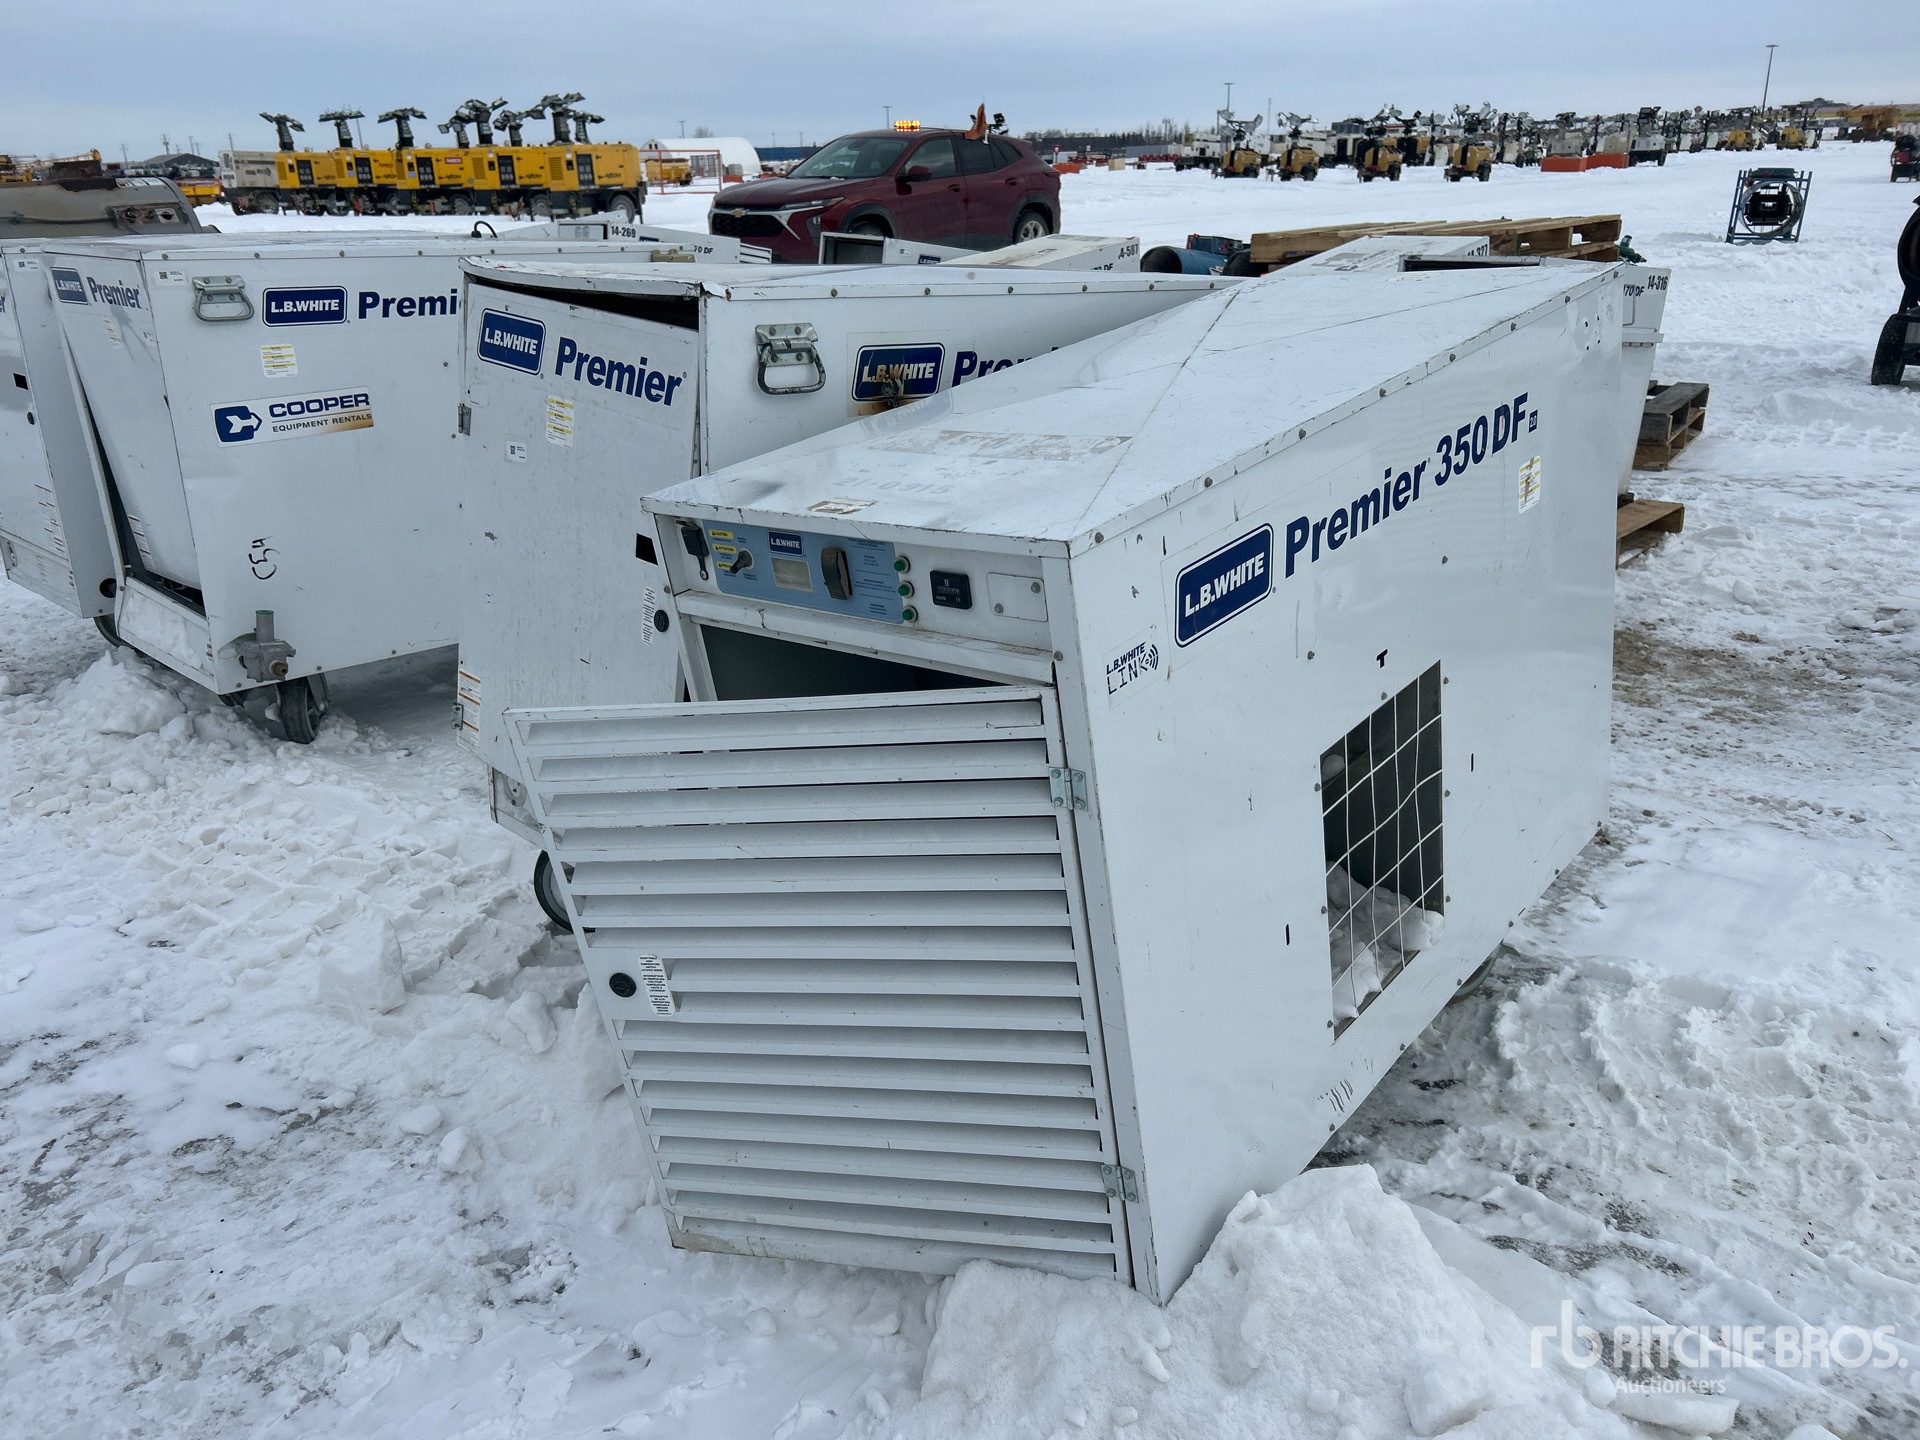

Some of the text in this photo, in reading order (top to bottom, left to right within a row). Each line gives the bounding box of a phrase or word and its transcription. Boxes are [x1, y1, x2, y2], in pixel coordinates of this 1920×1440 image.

[610, 225, 637, 239] 14-269
[86, 276, 141, 309] Premier
[1647, 274, 1669, 291] 14-316
[271, 299, 340, 314] L.B.WHITE
[358, 288, 461, 320] Premi
[484, 327, 539, 356] L.B.WHITE
[554, 336, 684, 407] Premier
[862, 362, 936, 383] L.B.WHITE
[268, 393, 370, 418] COOPER
[272, 413, 373, 433] EQUIPMENT RENTALS
[1284, 466, 1427, 579] Premier
[1434, 415, 1488, 487] 350
[1491, 391, 1529, 455] DF
[770, 538, 801, 549] L.B.WHITE
[1184, 551, 1265, 618] L.B.WHITE
[1106, 641, 1147, 675] L.B.WHITE
